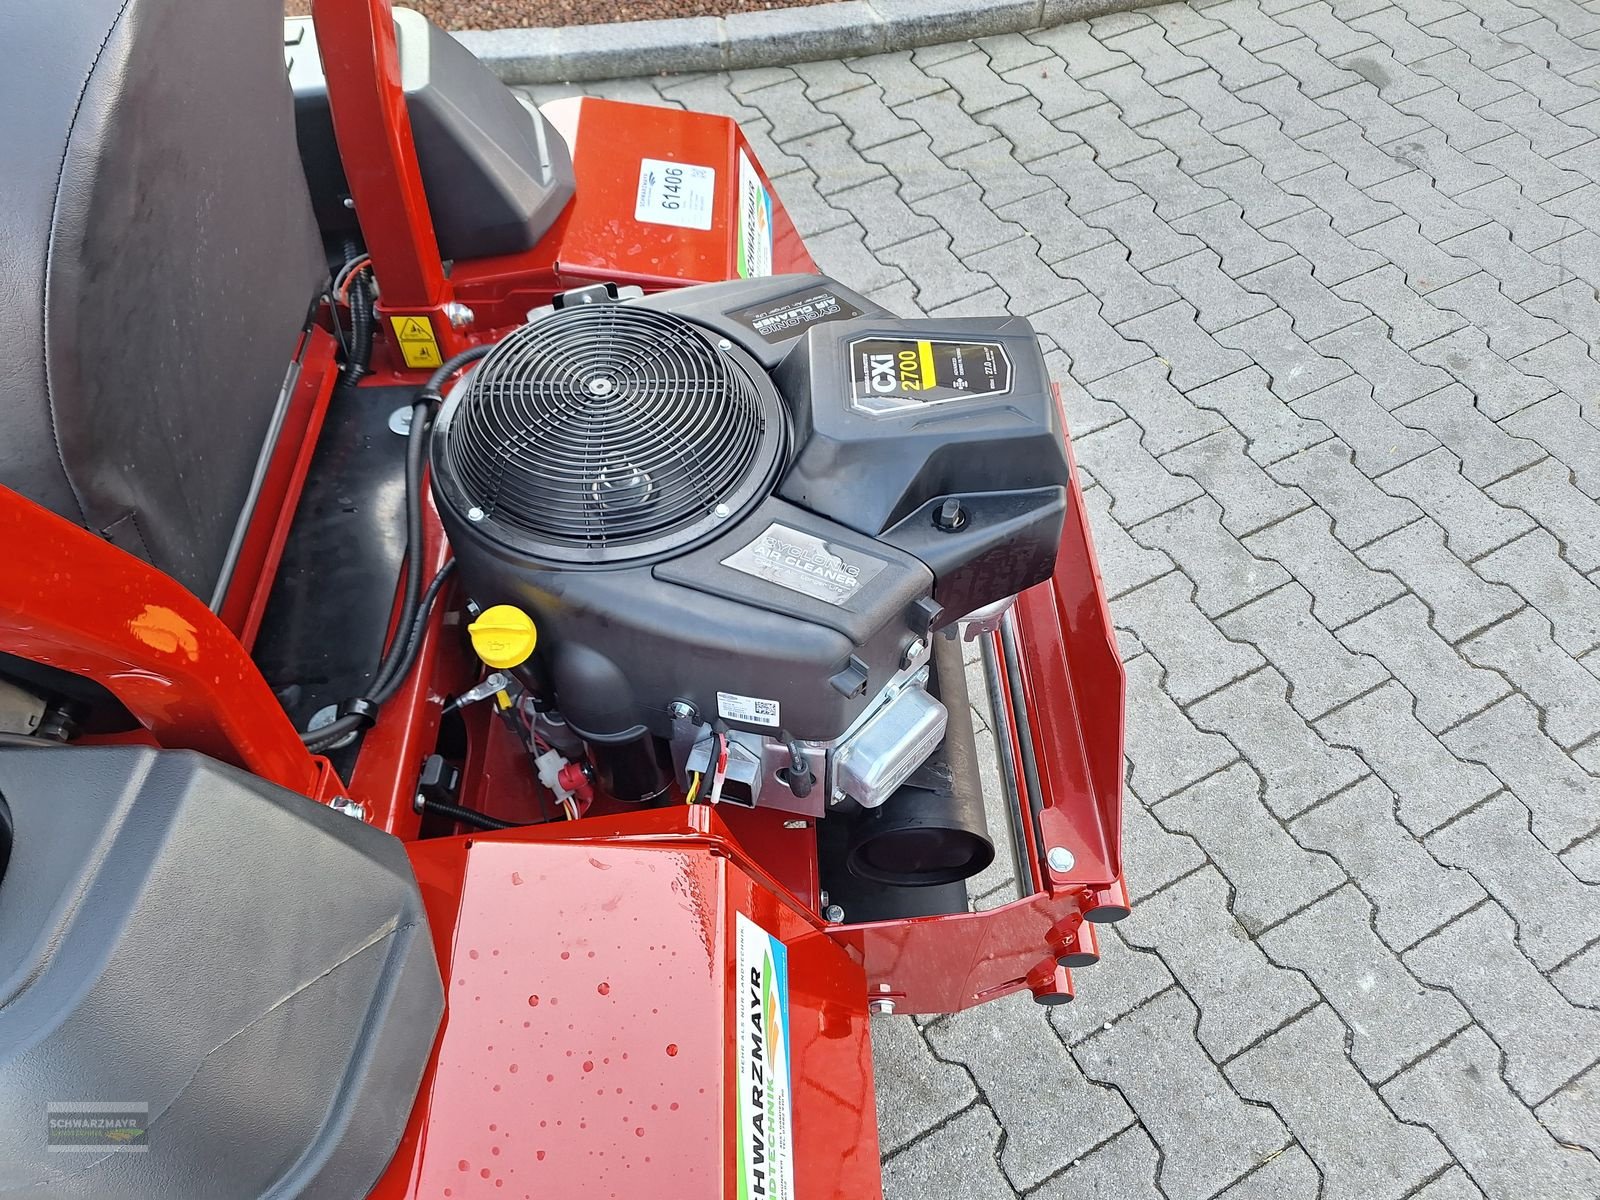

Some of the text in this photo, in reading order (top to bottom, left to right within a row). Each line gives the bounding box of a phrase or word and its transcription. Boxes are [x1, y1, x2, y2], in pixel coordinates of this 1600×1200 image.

[661, 168, 683, 209] 61406
[747, 180, 756, 278] SCHWARZMAYR
[753, 297, 836, 329] AIR CLEANER
[758, 304, 841, 336] CYCLONIC
[898, 350, 920, 391] 2700
[984, 361, 993, 375] 27.0
[754, 546, 858, 587] AIR CLEANER
[764, 536, 861, 578] CYCLONIC
[751, 967, 765, 1200] HWARZMAYR
